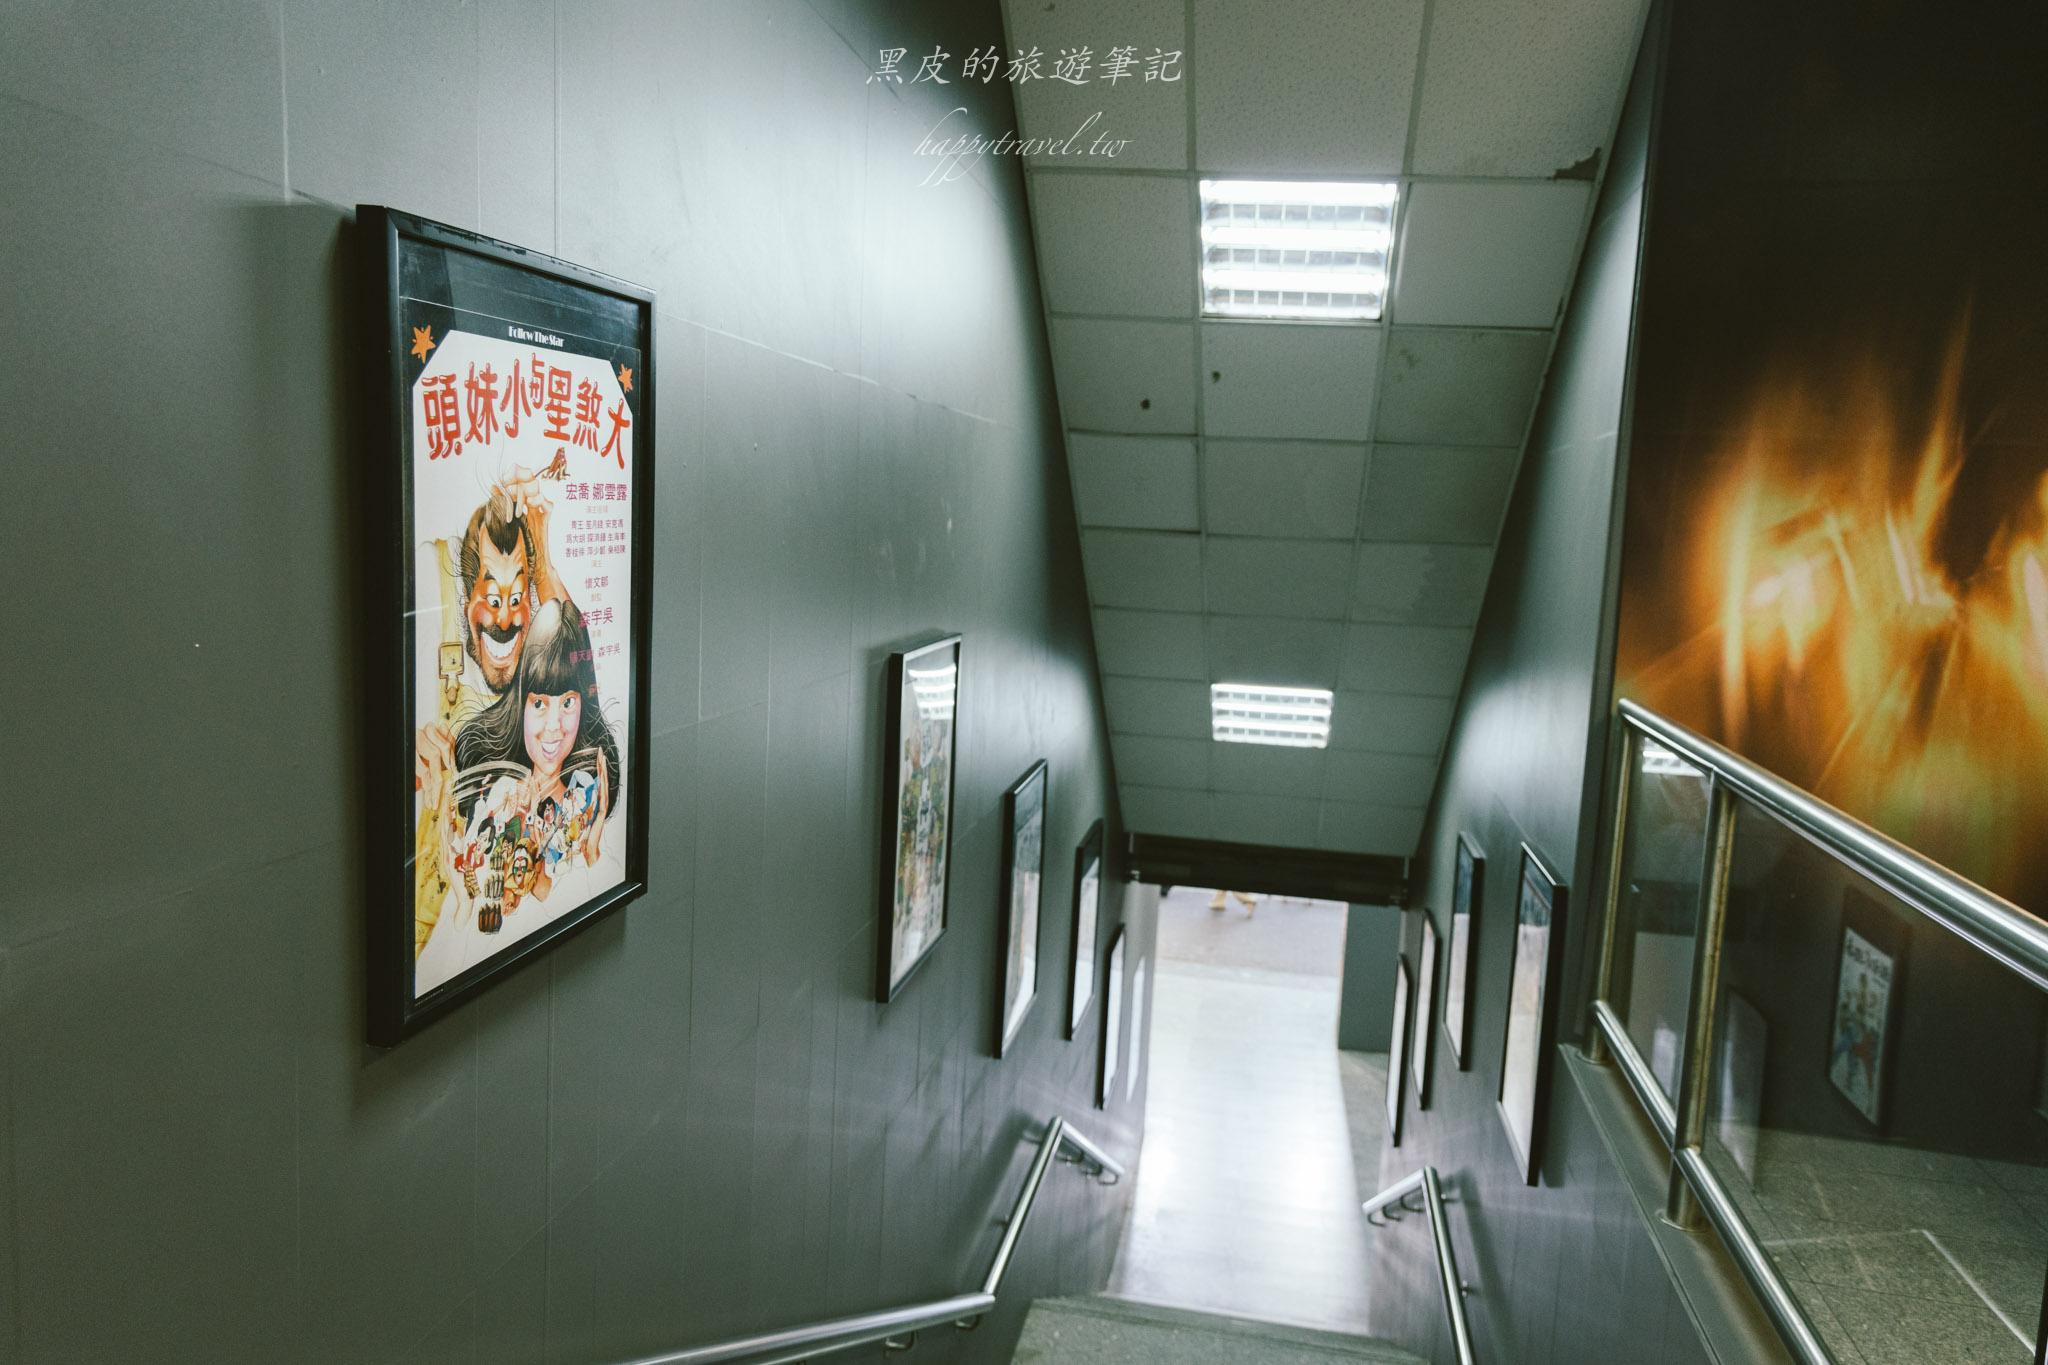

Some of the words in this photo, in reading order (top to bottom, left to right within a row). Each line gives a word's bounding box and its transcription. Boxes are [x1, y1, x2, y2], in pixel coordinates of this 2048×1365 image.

[508, 325, 533, 341] Follow
[534, 331, 549, 344] The
[549, 334, 565, 347] Star
